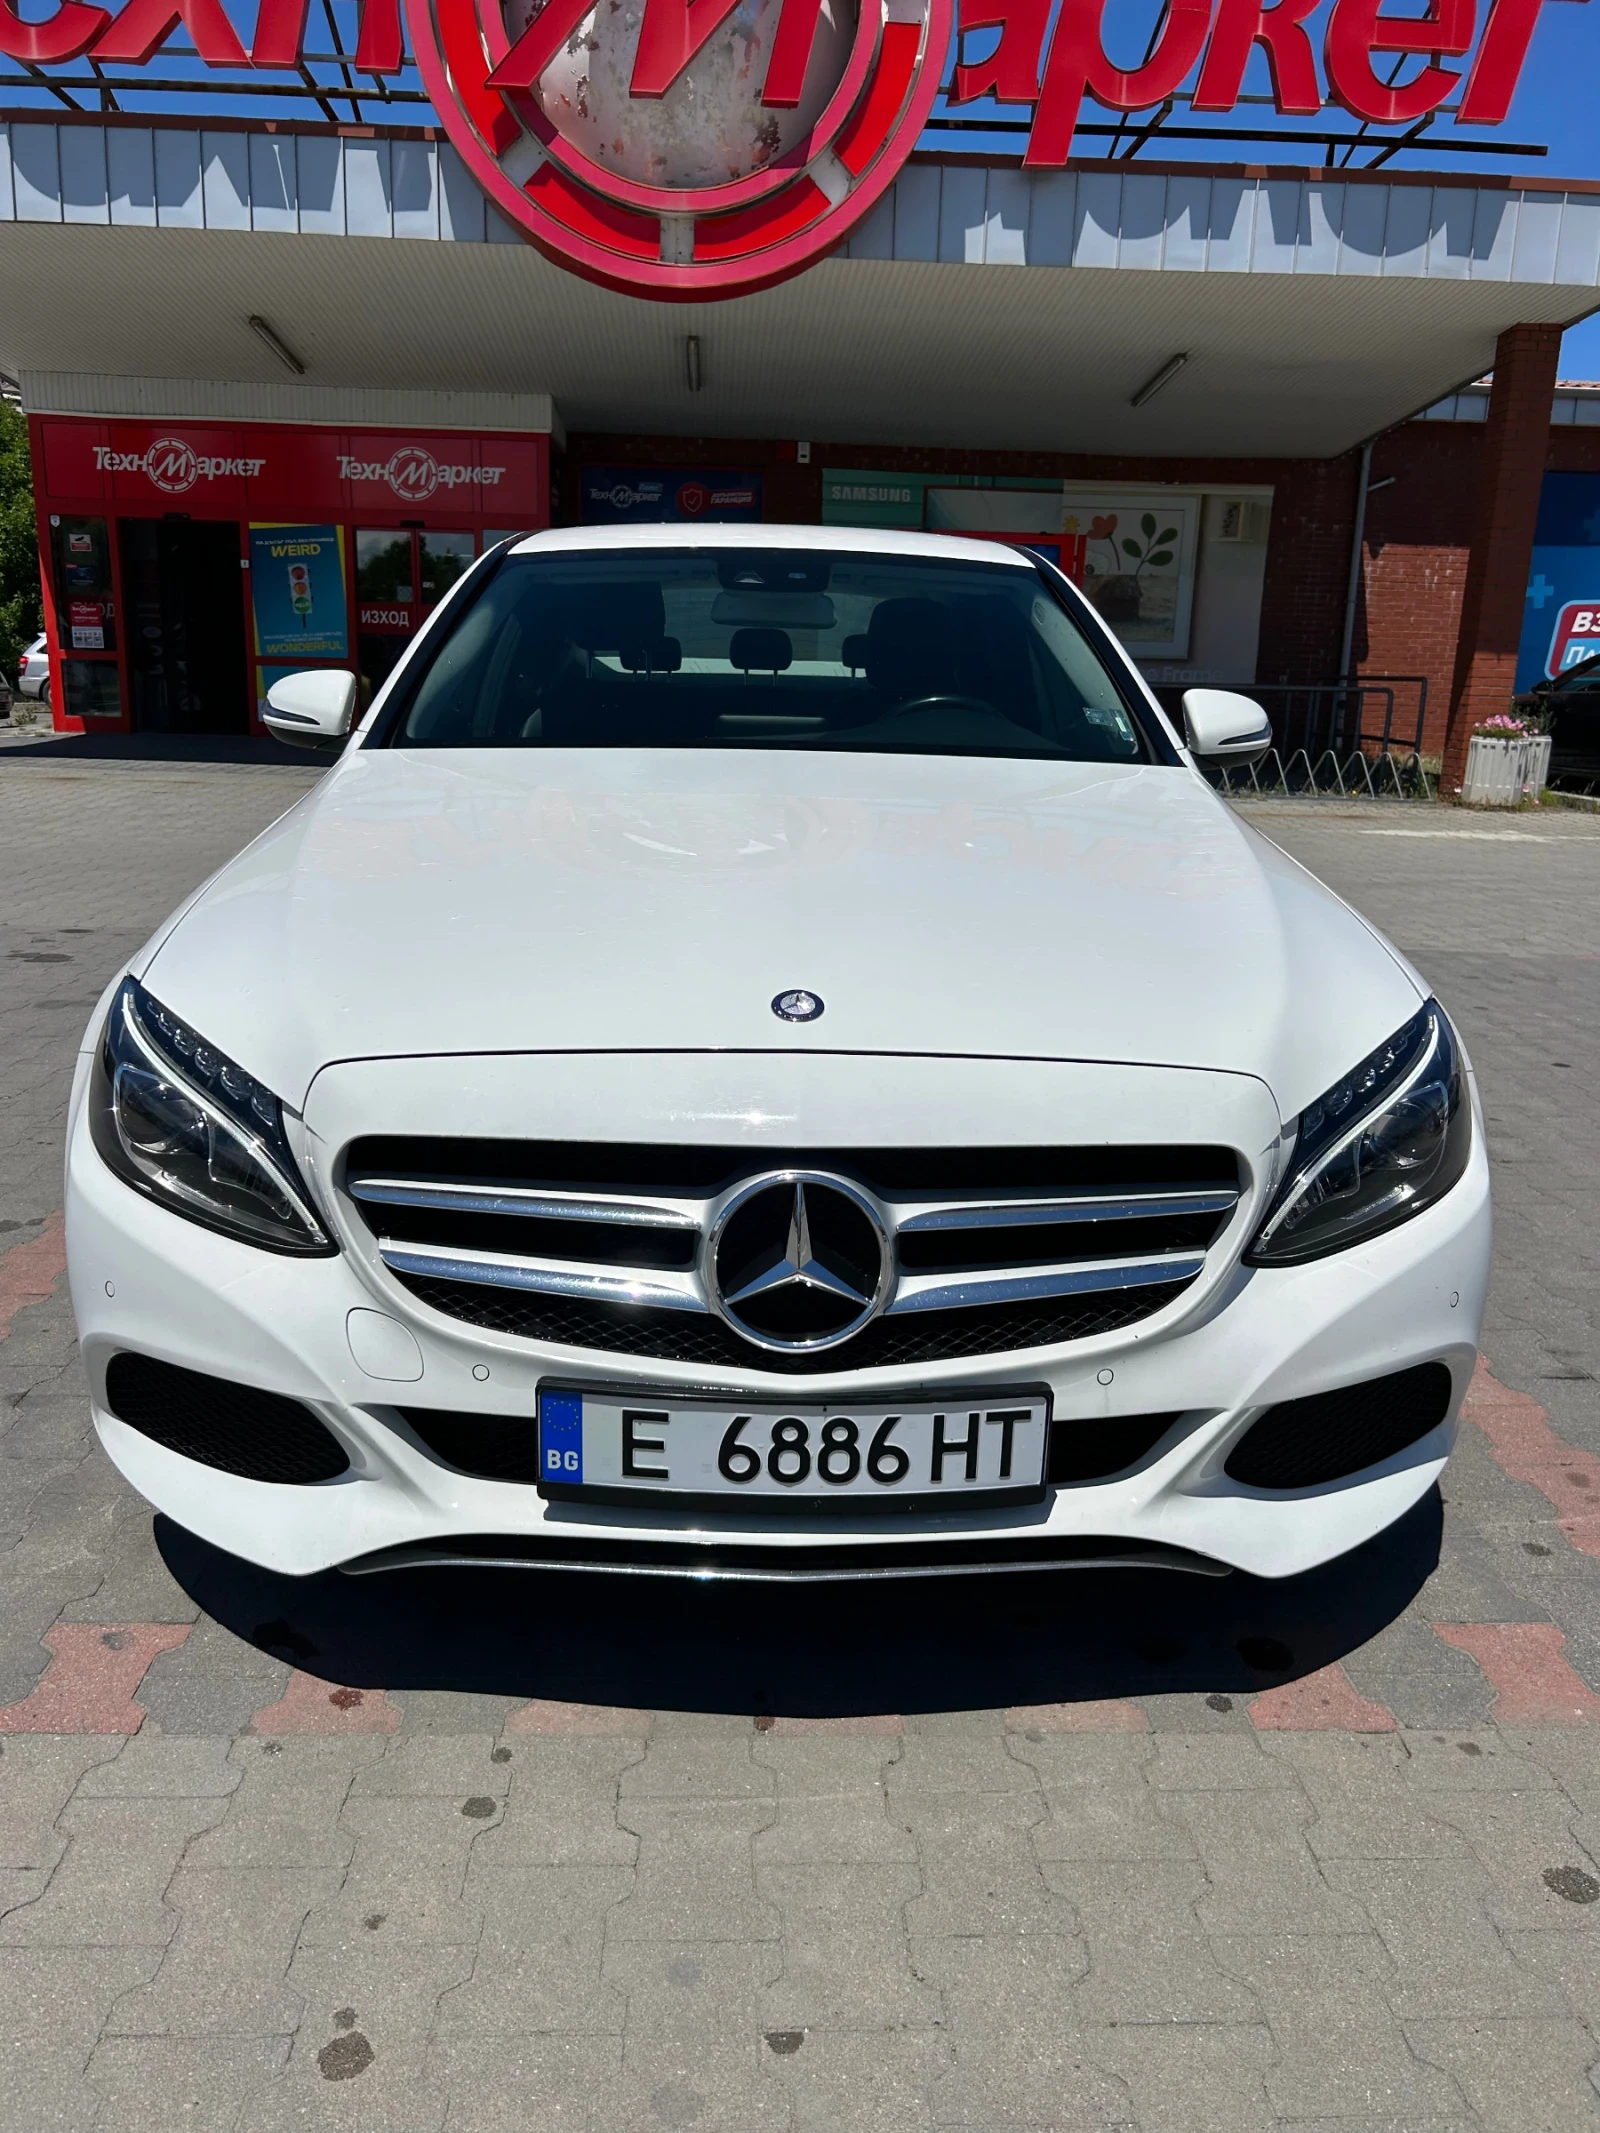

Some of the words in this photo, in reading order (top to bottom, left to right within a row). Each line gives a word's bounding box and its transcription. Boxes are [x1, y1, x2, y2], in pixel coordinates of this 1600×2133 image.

[831, 485, 911, 503] SAMSUNG
[271, 543, 321, 557] WEIRD
[361, 609, 409, 627] ИЗХОД
[266, 640, 344, 654] WONDERFUL
[1163, 665, 1223, 683] Frame
[621, 1409, 669, 1479] E
[716, 1416, 910, 1484] 6886
[930, 1408, 1032, 1483] HT
[547, 1449, 578, 1471] BG
